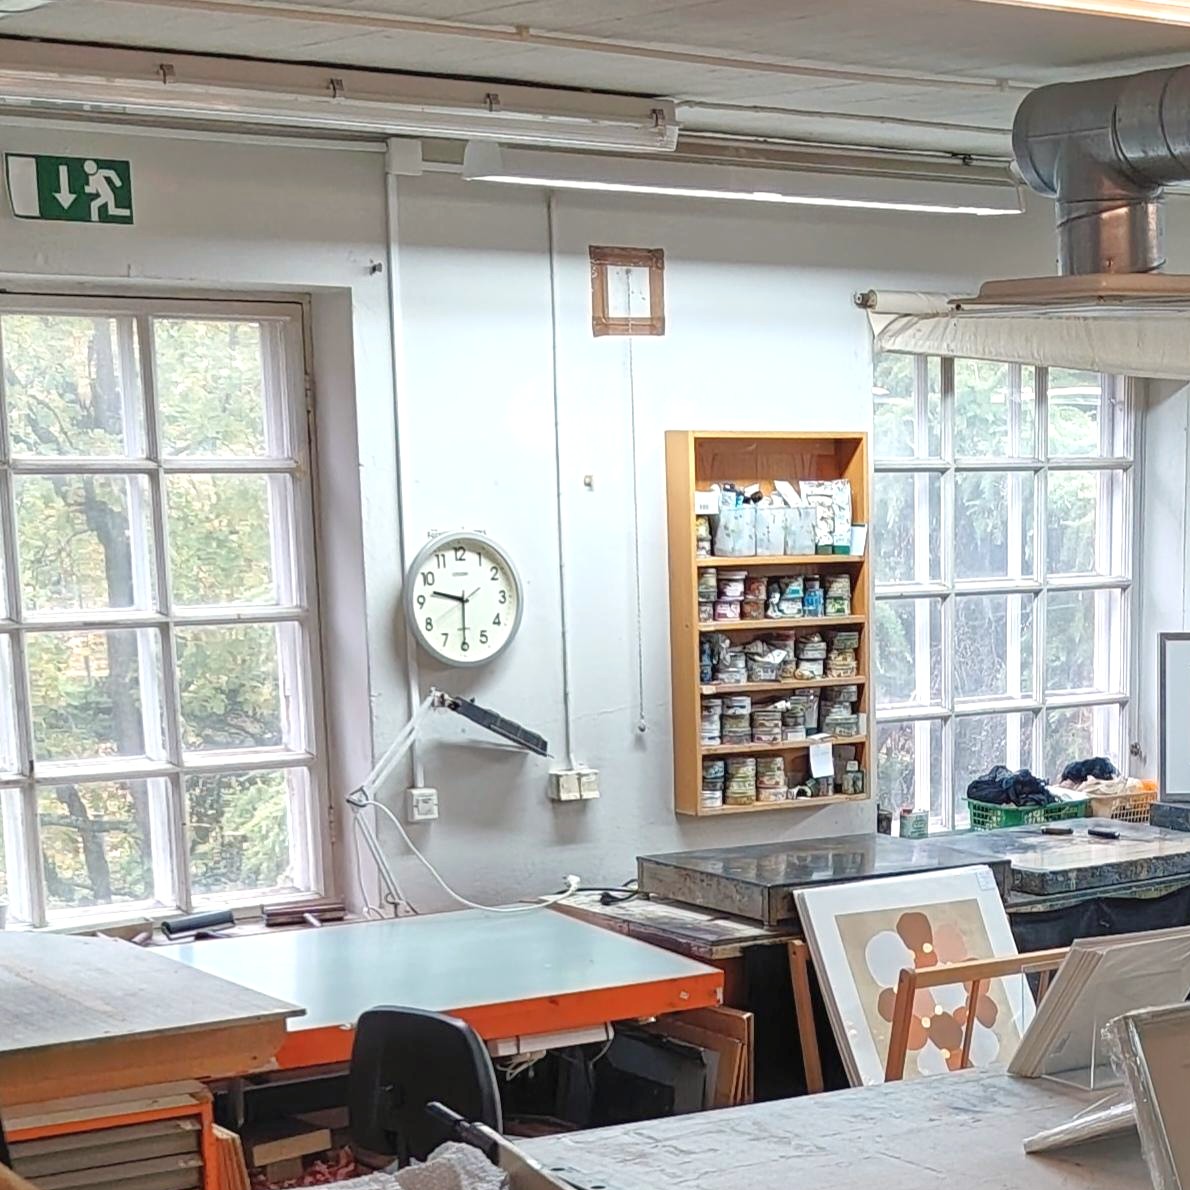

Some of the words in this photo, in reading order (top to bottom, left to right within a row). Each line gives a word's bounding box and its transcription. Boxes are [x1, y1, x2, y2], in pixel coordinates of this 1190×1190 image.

[453, 546, 466, 561] 12
[476, 551, 482, 567] 1
[435, 553, 446, 569] 11
[421, 571, 435, 586] 10
[490, 566, 499, 581] 2
[416, 595, 426, 609] 9
[498, 590, 507, 604] 3
[425, 617, 433, 631] 8
[492, 613, 501, 626] 4
[441, 632, 449, 647] 7
[479, 630, 488, 644] 5
[460, 638, 470, 652] 6
